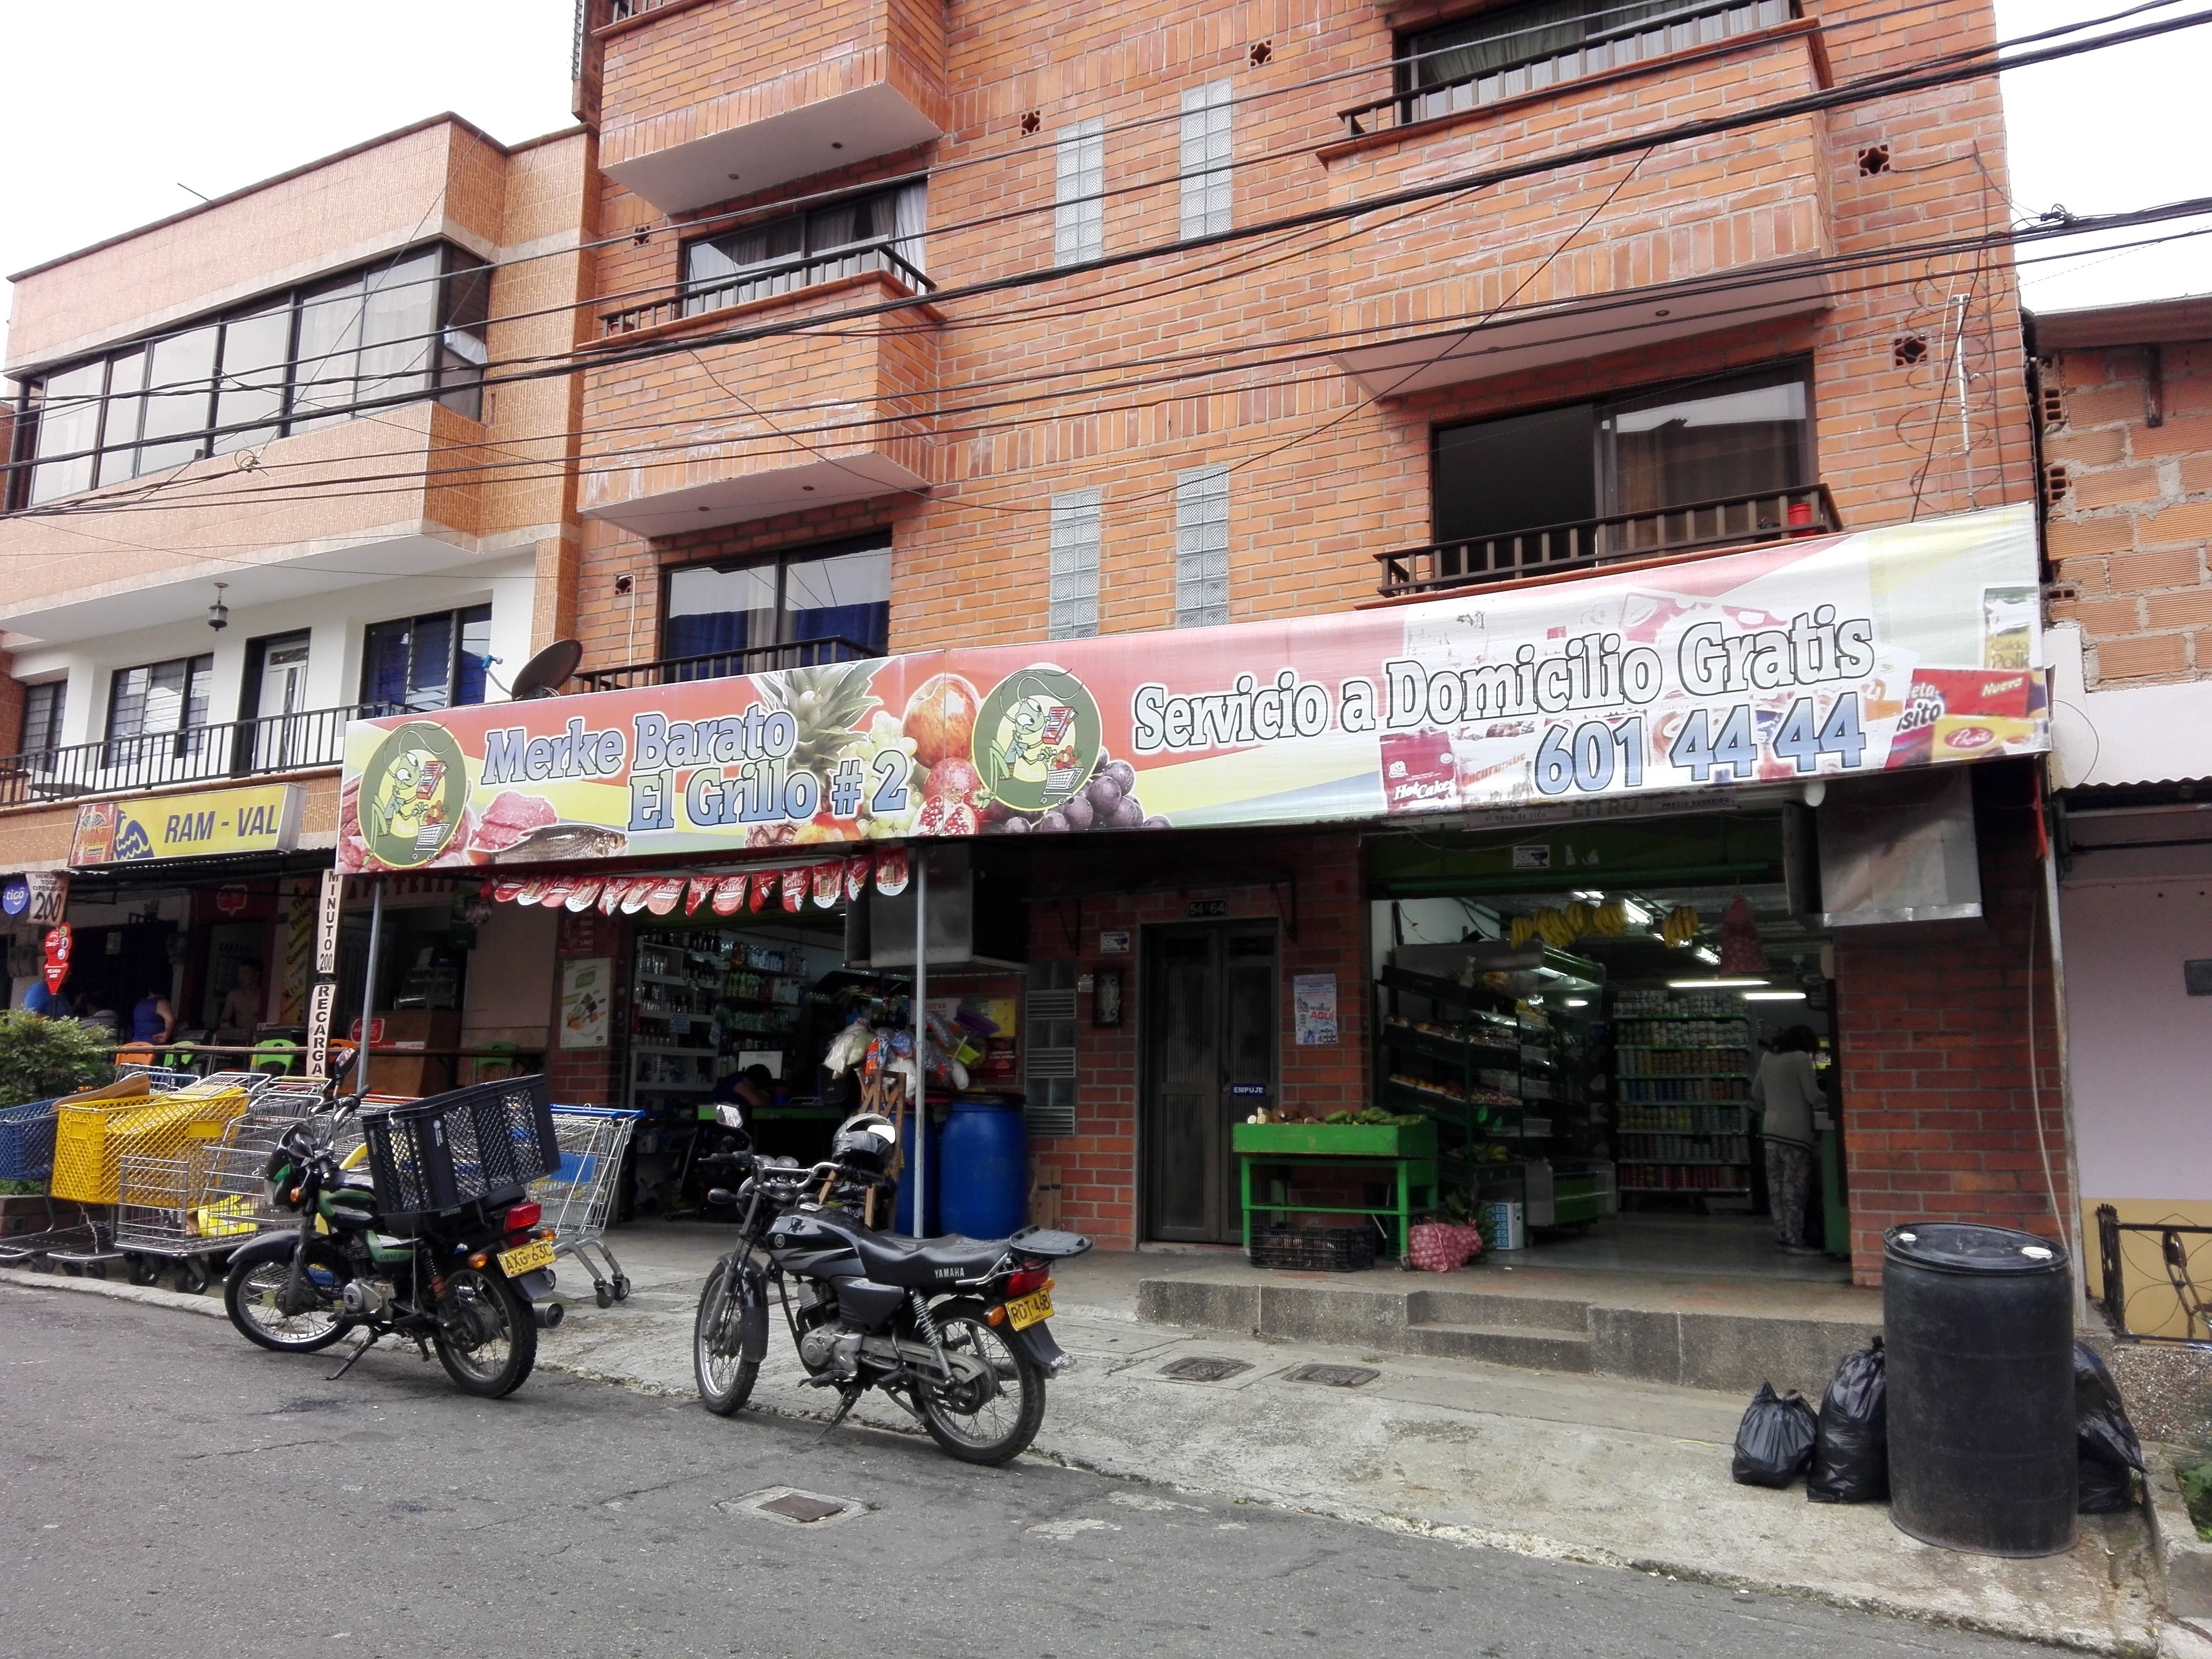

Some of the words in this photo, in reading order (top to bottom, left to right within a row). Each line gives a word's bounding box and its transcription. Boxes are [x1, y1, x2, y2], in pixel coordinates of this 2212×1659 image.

[1135, 671, 1329, 750] Servicio
[1342, 680, 1377, 732] a
[1386, 633, 1662, 728] Domicilio
[1678, 604, 1875, 697] Gratis
[481, 718, 623, 785] Merke
[633, 703, 795, 772] Barato
[1535, 717, 1643, 795] 601
[1670, 704, 1757, 782] 44
[1773, 692, 1866, 773] 44
[628, 769, 674, 831] El
[686, 759, 818, 828] Grillo
[1662, 800, 1690, 808] PRECIO
[1691, 797, 1730, 806] SUGERIDO
[164, 811, 215, 843] RAM
[238, 805, 277, 836] VAL
[1495, 815, 1514, 823] agua
[33, 892, 62, 921] 200
[324, 870, 339, 951] MINUTO
[320, 953, 332, 971] 200
[312, 985, 330, 1077] RECARGA
[505, 1251, 528, 1271] AXG
[532, 1243, 552, 1261] 63C
[935, 1268, 965, 1279] YAMAHA
